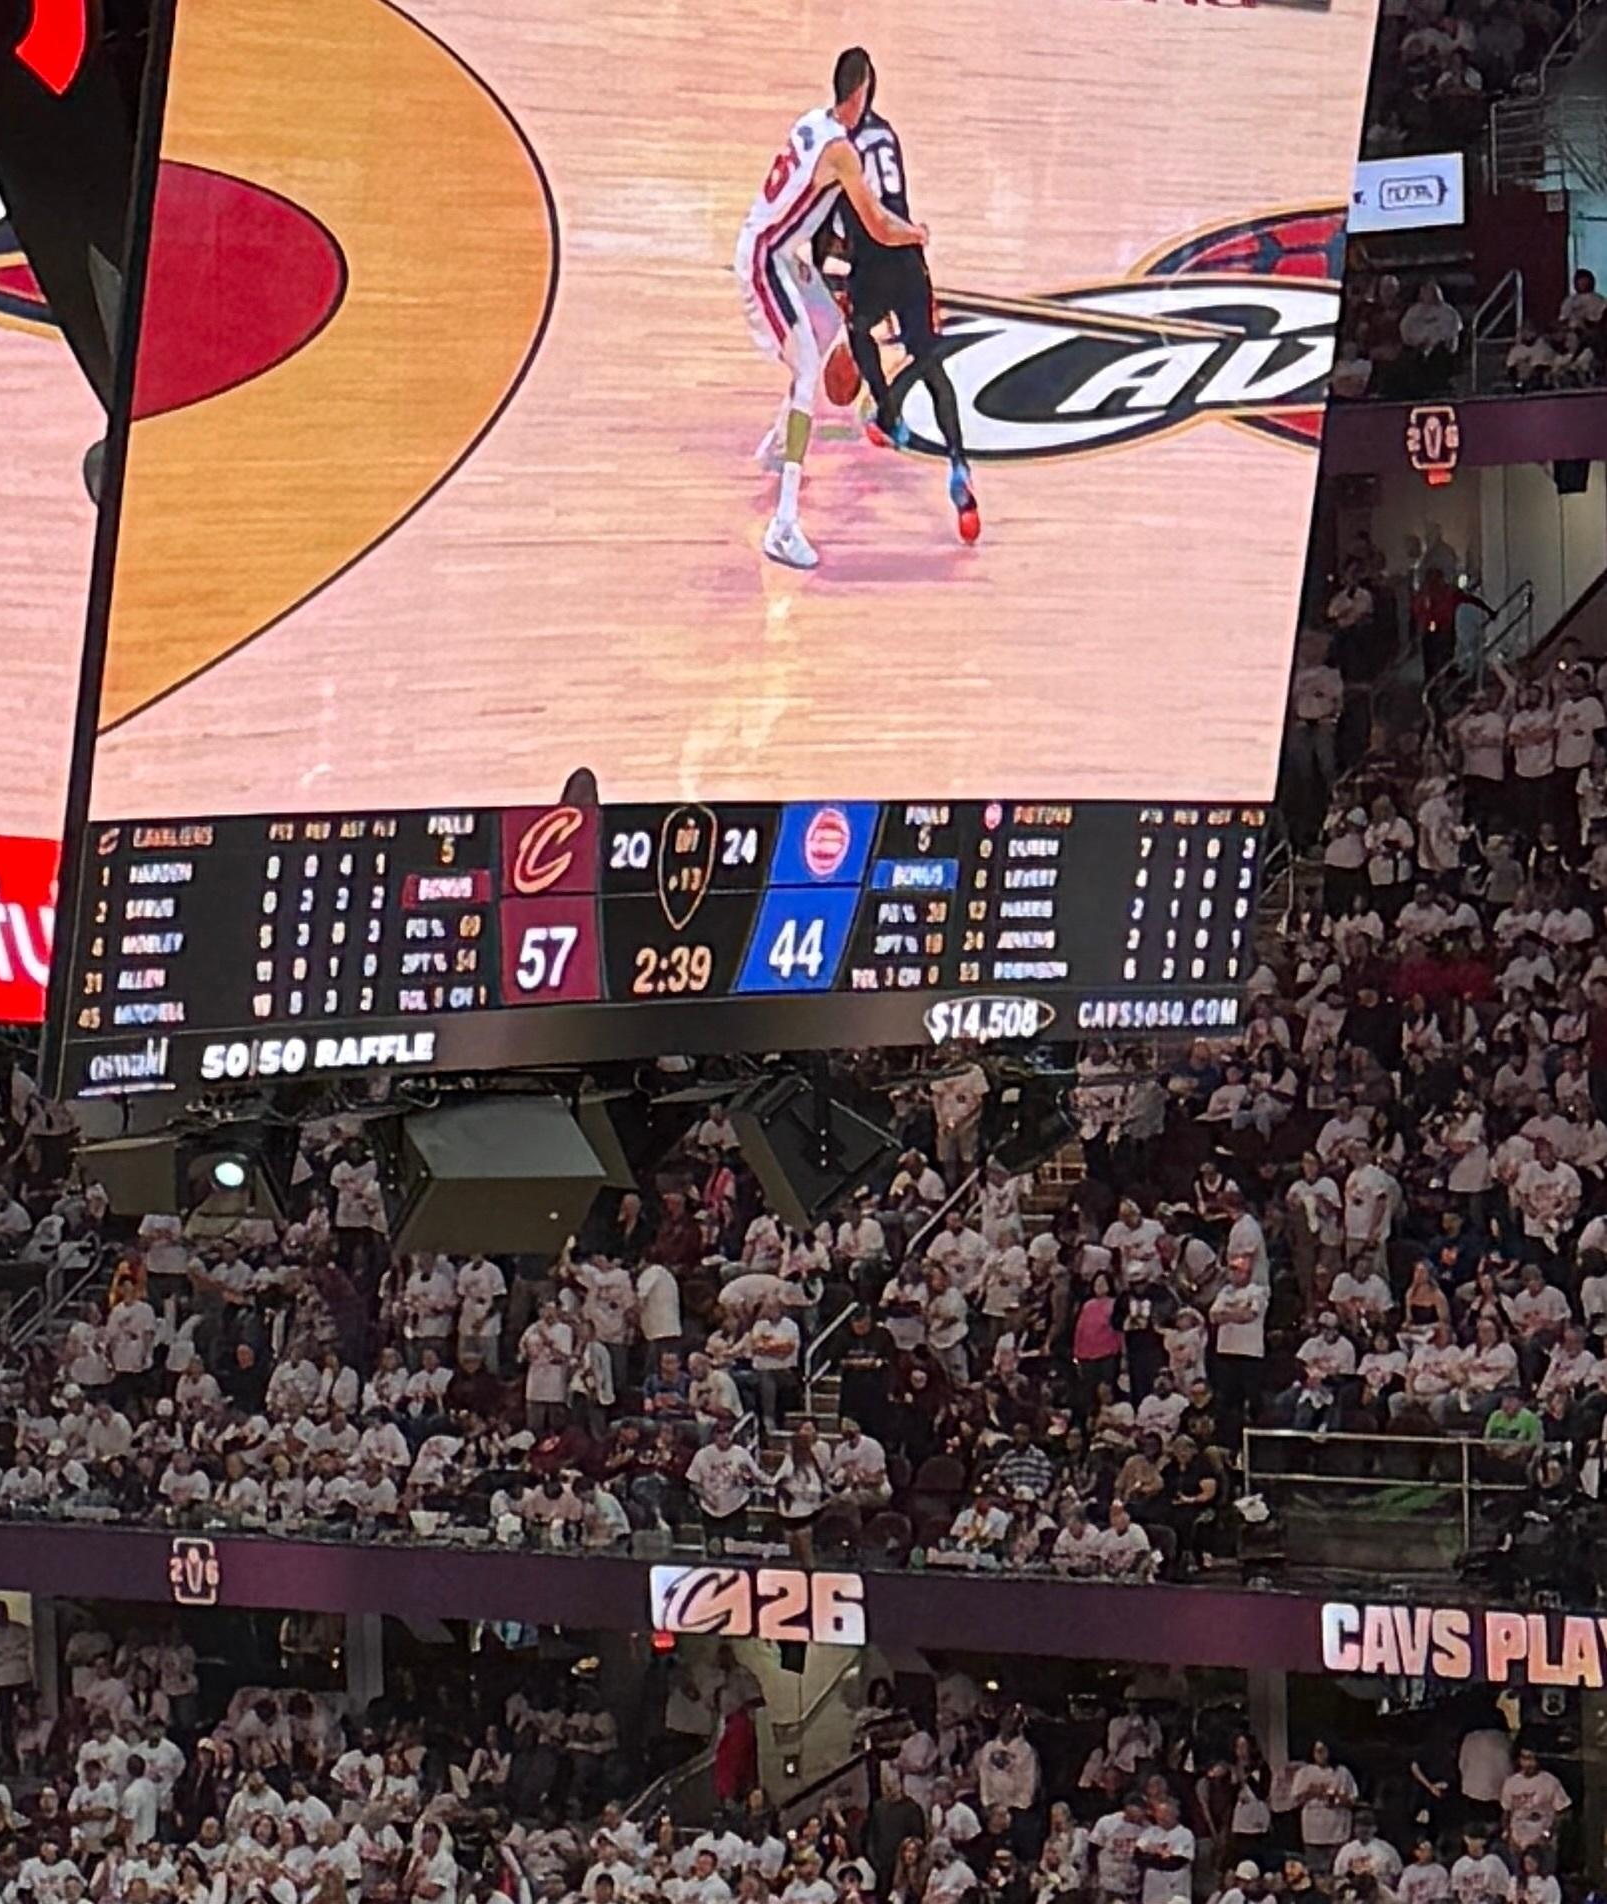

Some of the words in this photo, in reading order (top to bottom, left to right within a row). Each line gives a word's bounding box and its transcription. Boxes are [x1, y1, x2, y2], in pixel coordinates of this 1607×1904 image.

[441, 837, 455, 863] 5
[722, 828, 758, 864] 24
[516, 927, 578, 989] 57
[633, 946, 712, 992] 2:39
[769, 919, 823, 979] 44
[930, 999, 1038, 1044] $14,508
[314, 1032, 435, 1068] RAFFLE
[756, 1568, 866, 1645] 26
[1322, 1602, 1471, 1678] CAVS
